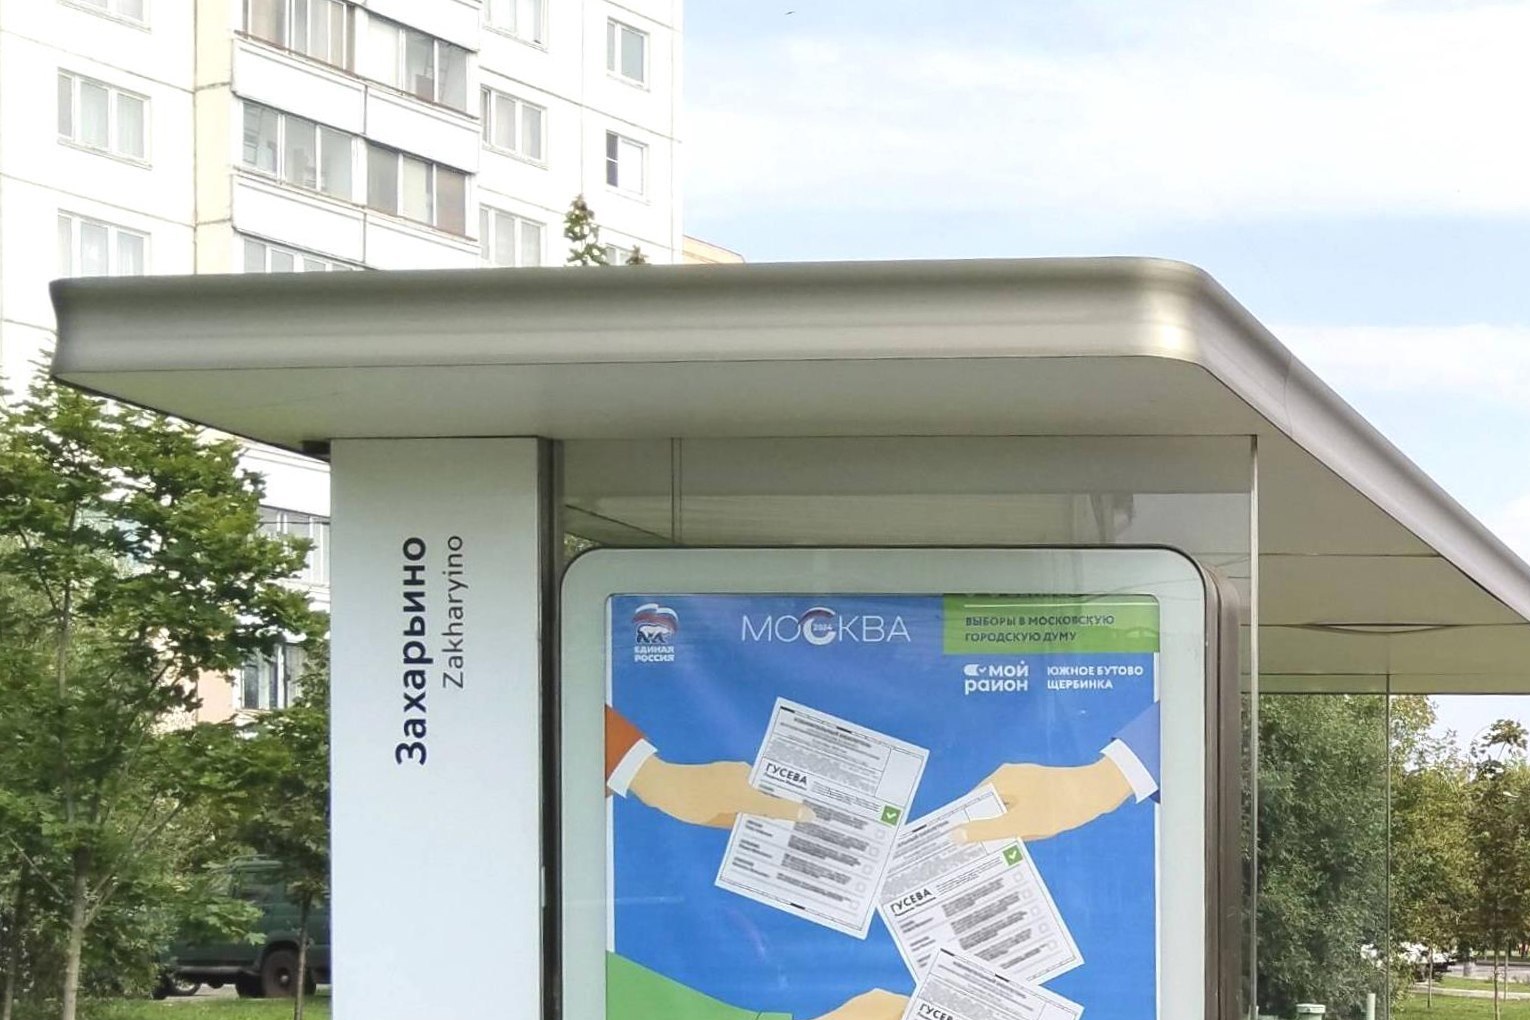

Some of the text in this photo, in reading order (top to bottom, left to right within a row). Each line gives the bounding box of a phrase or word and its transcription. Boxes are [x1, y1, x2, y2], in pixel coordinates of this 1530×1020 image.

[442, 535, 469, 689] Zakharyino
[965, 615, 1115, 627] ВЫБОРЫ В МОСКОВСКУЮ
[741, 607, 911, 645] МОСКВА
[965, 631, 1077, 643] ГОРОДСКУЮ ДУМУ
[395, 537, 433, 766] Захарьино
[634, 654, 675, 663] РОССИЯ
[1047, 665, 1144, 676] ЮЖНОЕ БУТОВО
[1047, 680, 1113, 690] ЩЕРБИНКА
[766, 762, 807, 786] ГУСЕВА
[890, 888, 932, 914] ГУСЕВА
